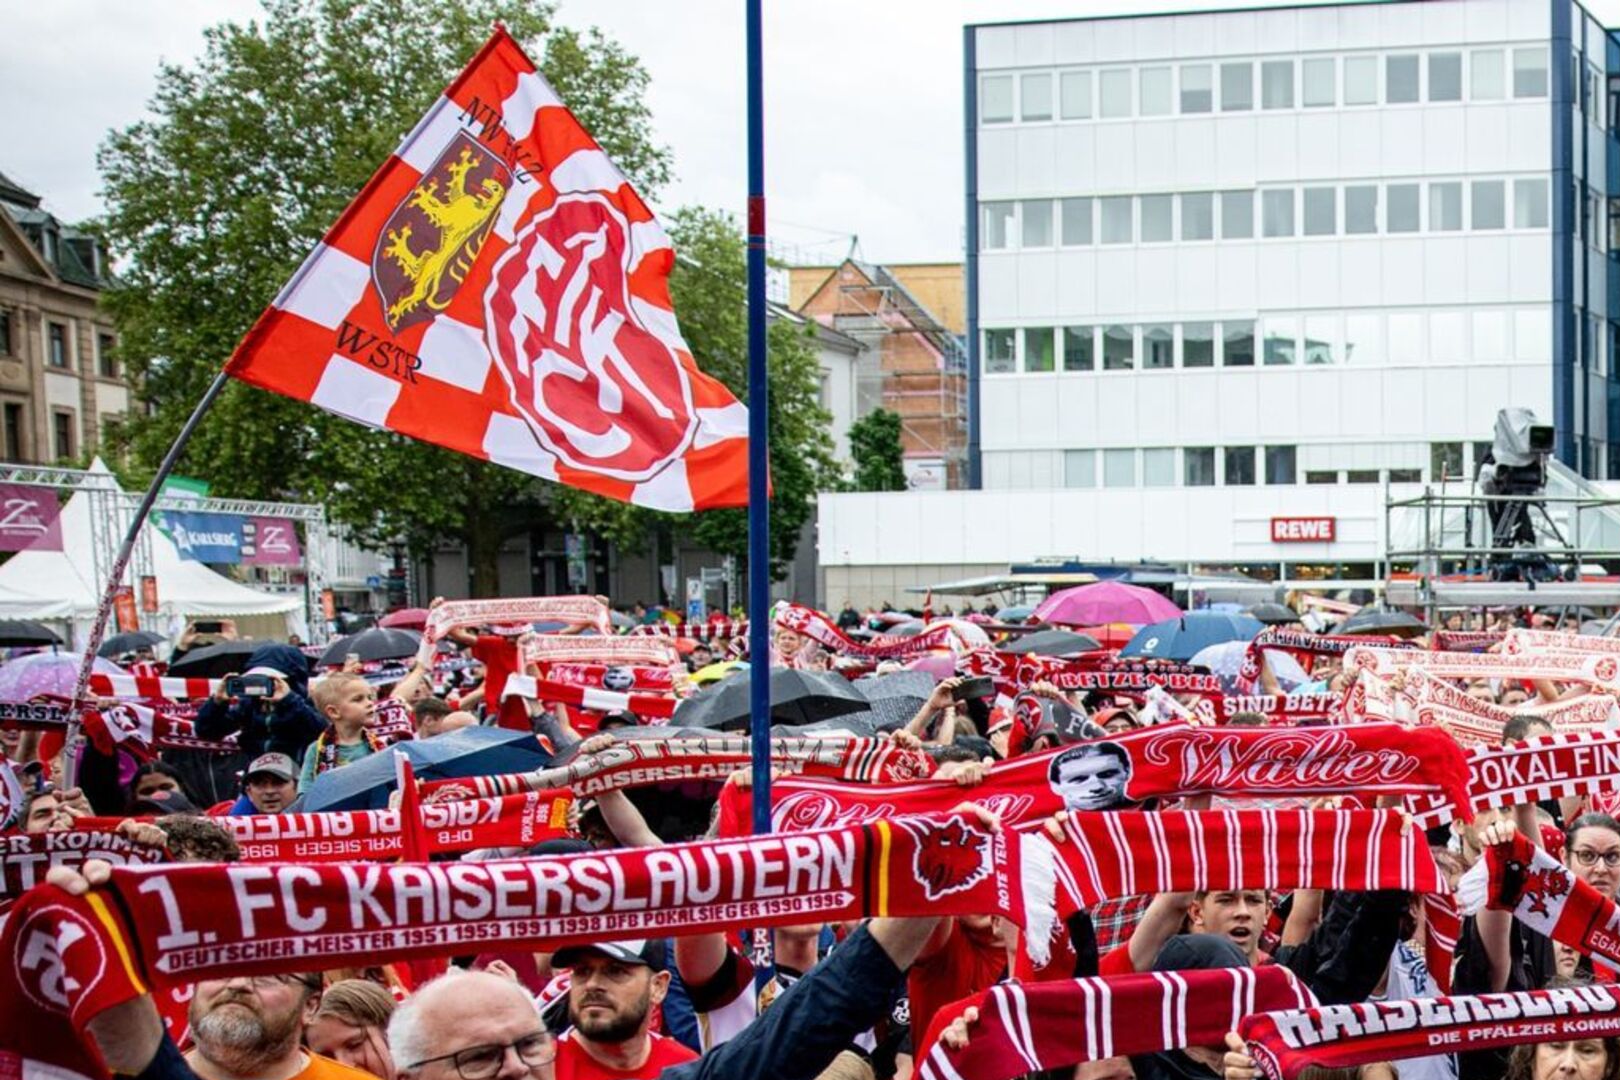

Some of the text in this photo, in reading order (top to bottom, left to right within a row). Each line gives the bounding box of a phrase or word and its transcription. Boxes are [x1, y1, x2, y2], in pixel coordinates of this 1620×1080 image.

[337, 321, 423, 385] WSTR
[1274, 519, 1332, 539] REWE
[1223, 694, 1279, 717] SIND
[1065, 711, 1098, 740] FC
[1147, 731, 1421, 789] Walter
[423, 797, 504, 830] KAIS
[437, 828, 473, 845] DFB
[138, 828, 856, 950] 1. FC KAISERSLAUTERN
[995, 876, 1011, 912] ROTE
[168, 893, 845, 971] DEUTSCHER MEISTER 1951 1953 1991 1998 DFB POKALSIEGER 1990 1996
[1428, 1030, 1464, 1047] DIE
